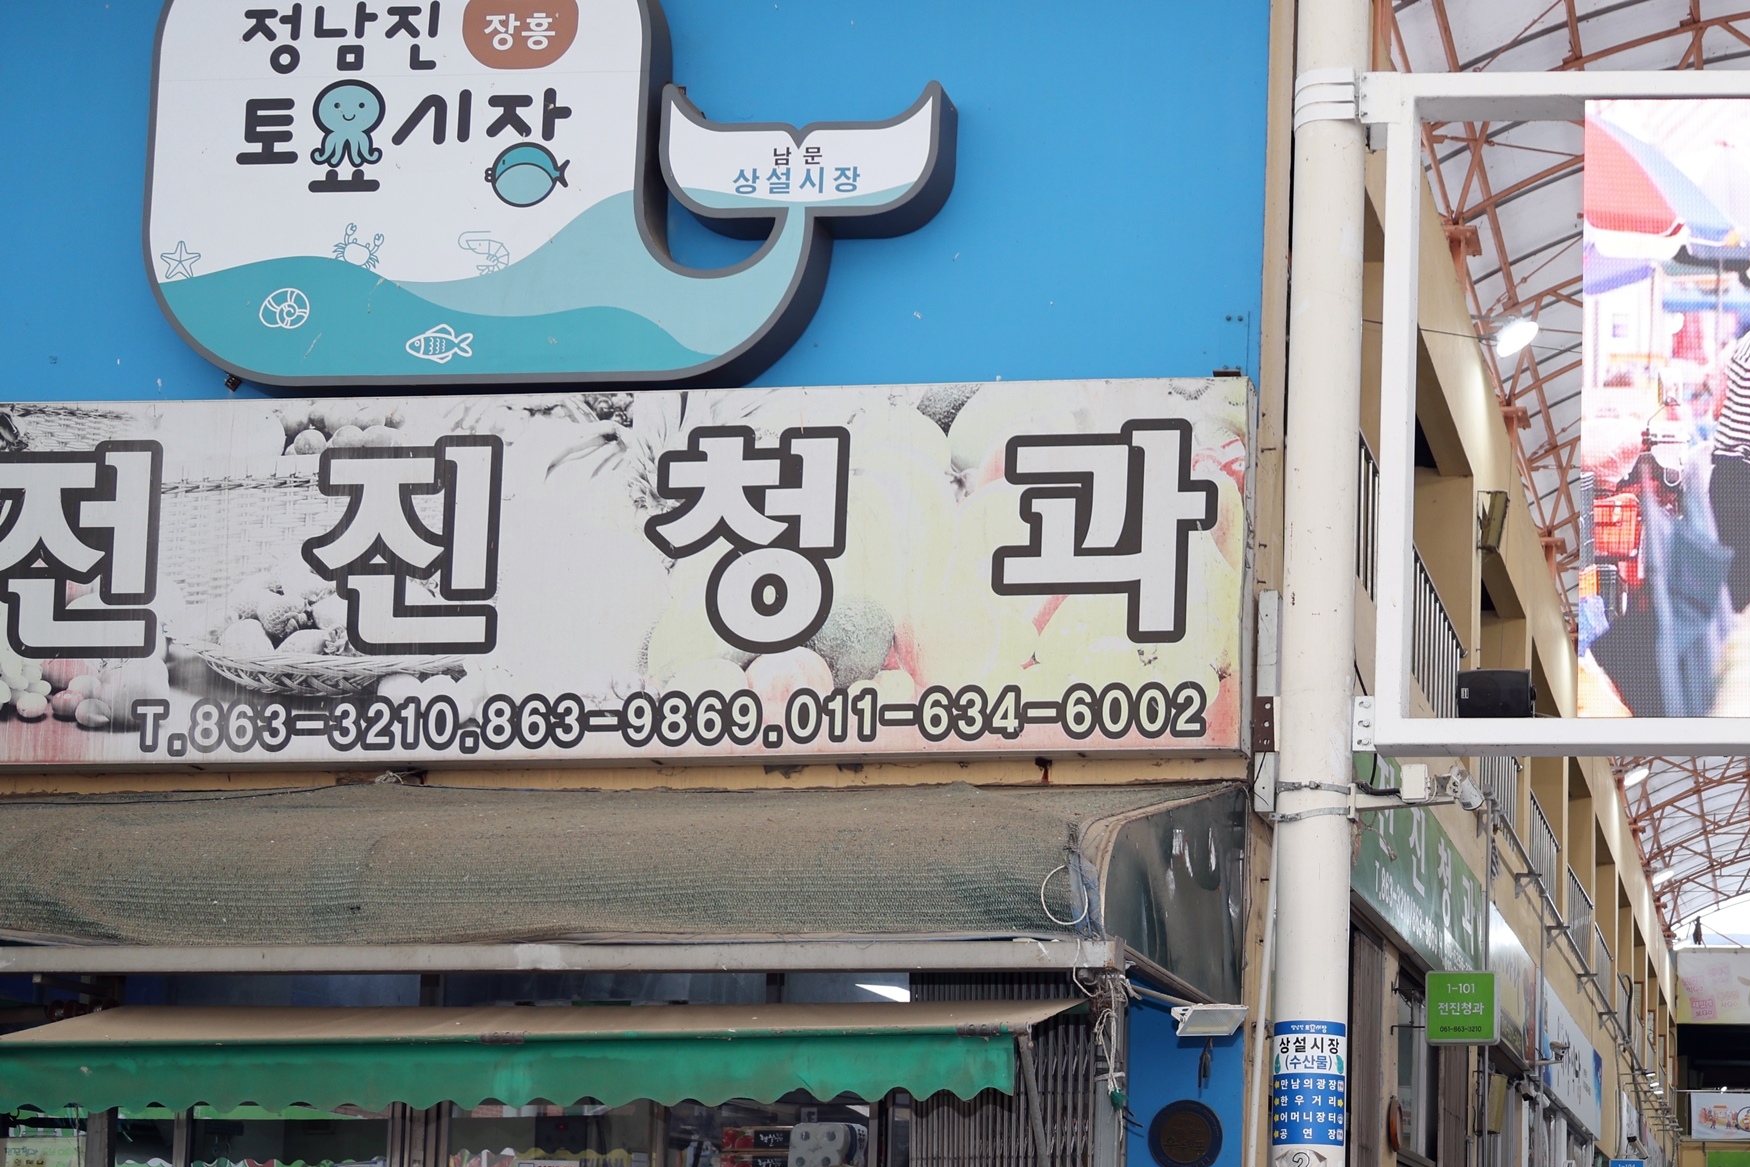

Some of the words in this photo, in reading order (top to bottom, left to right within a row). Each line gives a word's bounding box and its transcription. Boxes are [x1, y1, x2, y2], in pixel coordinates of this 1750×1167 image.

[241, 3, 441, 75] 정남진
[484, 13, 557, 49] 장흥
[773, 147, 824, 166] 남문
[733, 166, 861, 195] 상설시장
[1447, 983, 1476, 994] 1-101
[1438, 1002, 1484, 1016] 전진청과
[1440, 1025, 1482, 1033] 061-863-3210
[1279, 1036, 1340, 1054] 상설시장
[1285, 1055, 1333, 1070] (수산물)
[1280, 1078, 1336, 1090] 만남의광장
[1280, 1095, 1336, 1107] 한우거리
[1280, 1111, 1336, 1123] 어머니장터
[1279, 1128, 1336, 1140] 공연장
